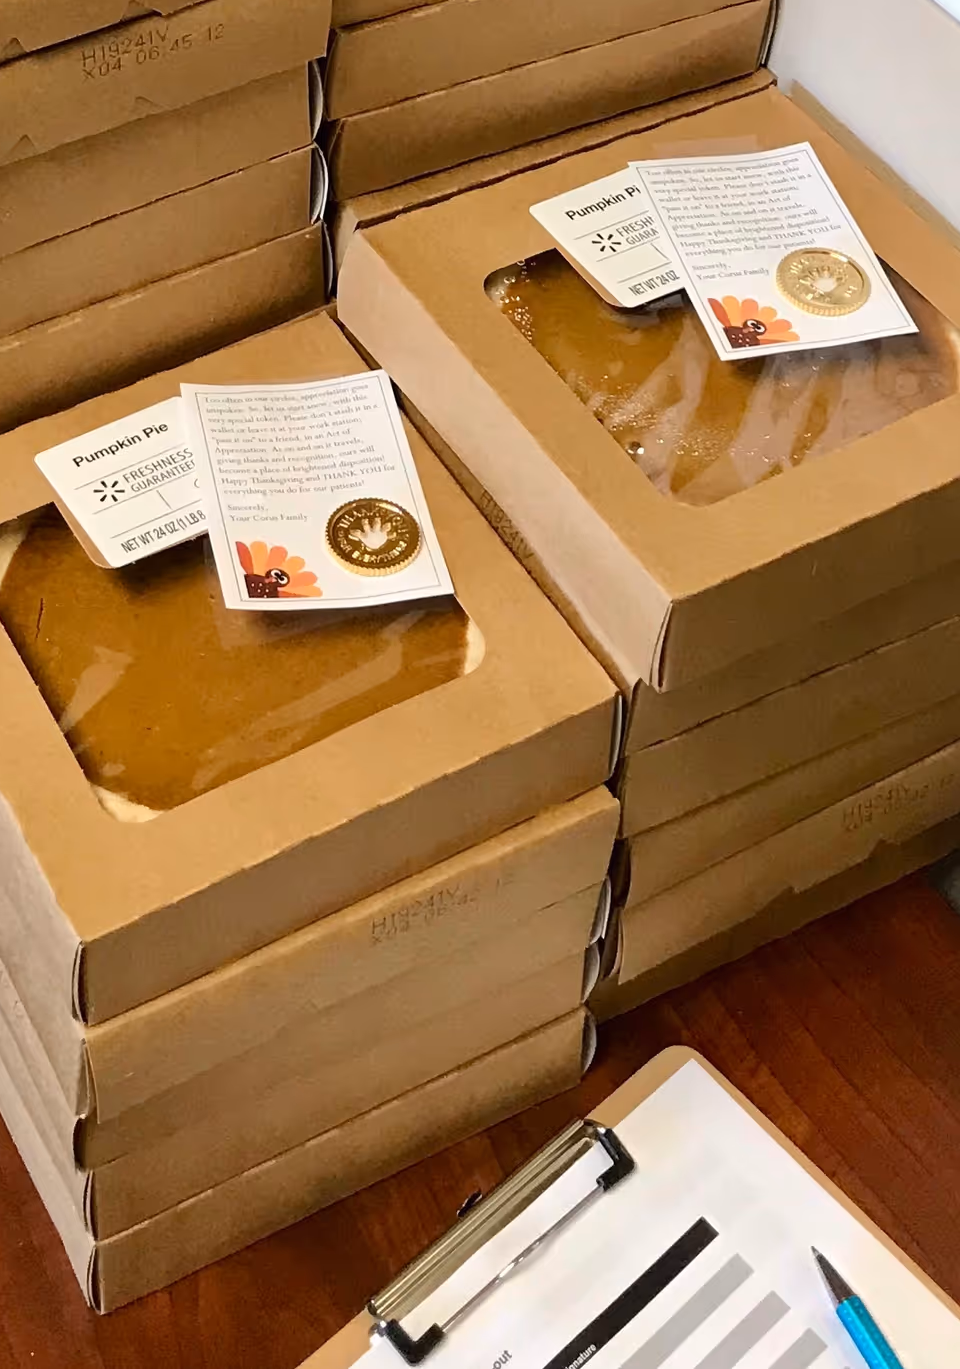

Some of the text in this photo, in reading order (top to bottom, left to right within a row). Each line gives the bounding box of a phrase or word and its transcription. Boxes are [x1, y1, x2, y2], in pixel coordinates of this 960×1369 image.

[82, 26, 169, 68] H19241V
[82, 58, 123, 81] X04
[207, 24, 224, 41] 12
[565, 193, 627, 220] Pumpkin
[628, 283, 644, 296] NET
[643, 278, 658, 290] WT
[656, 274, 670, 286] 24
[72, 423, 168, 468] Pumpkin Pie
[122, 448, 193, 483] FRESHNESS
[323, 470, 356, 480] THANK
[359, 465, 381, 474] YOU
[120, 538, 140, 554] NET
[140, 530, 155, 546] WT
[152, 526, 167, 540] 24
[165, 520, 179, 534] OZ
[185, 512, 200, 525] LB
[279, 513, 307, 522] Family
[492, 1350, 512, 1369] out
